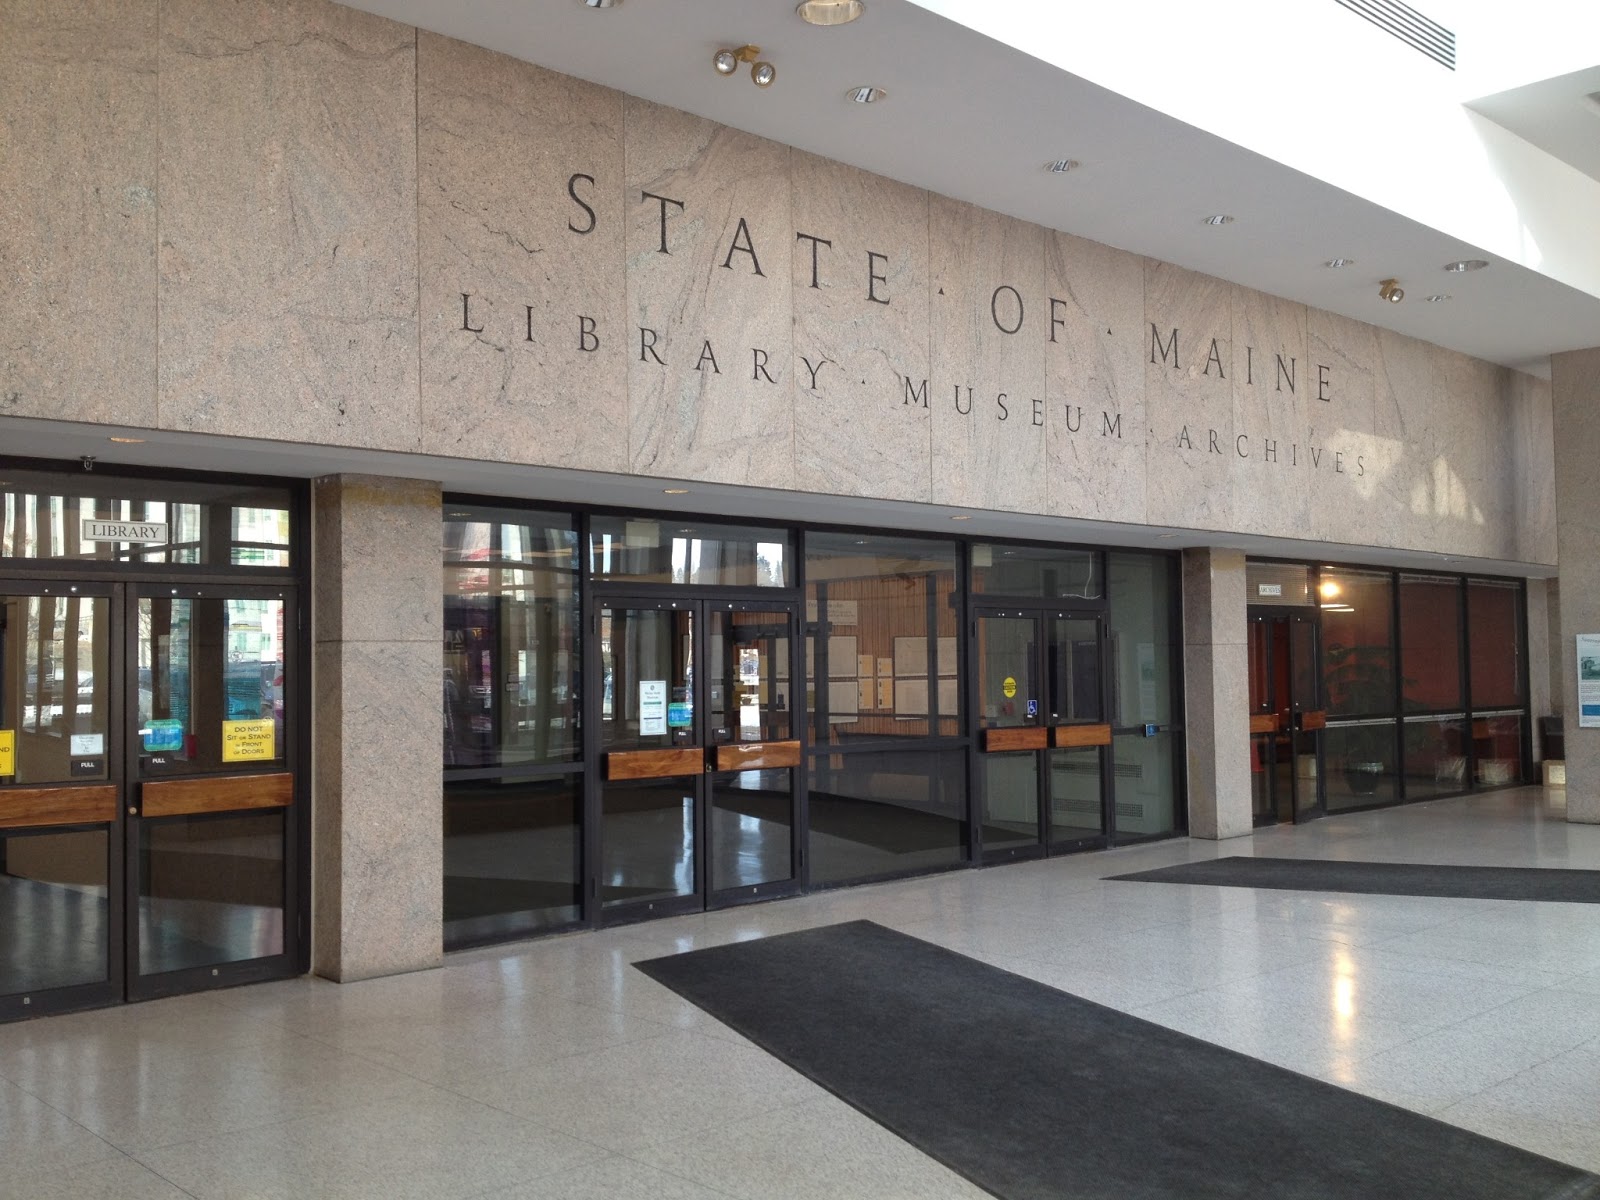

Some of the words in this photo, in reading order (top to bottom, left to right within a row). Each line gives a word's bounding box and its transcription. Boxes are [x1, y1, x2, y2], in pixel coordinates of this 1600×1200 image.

[566, 172, 891, 305] STATE
[990, 284, 1068, 343] OF
[1149, 321, 1333, 403] MAINE
[459, 292, 829, 390] LIBRARY
[903, 375, 1123, 440] MUSEUM
[1177, 424, 1366, 477] ARCHIVES
[92, 524, 159, 538] LIBRARY
